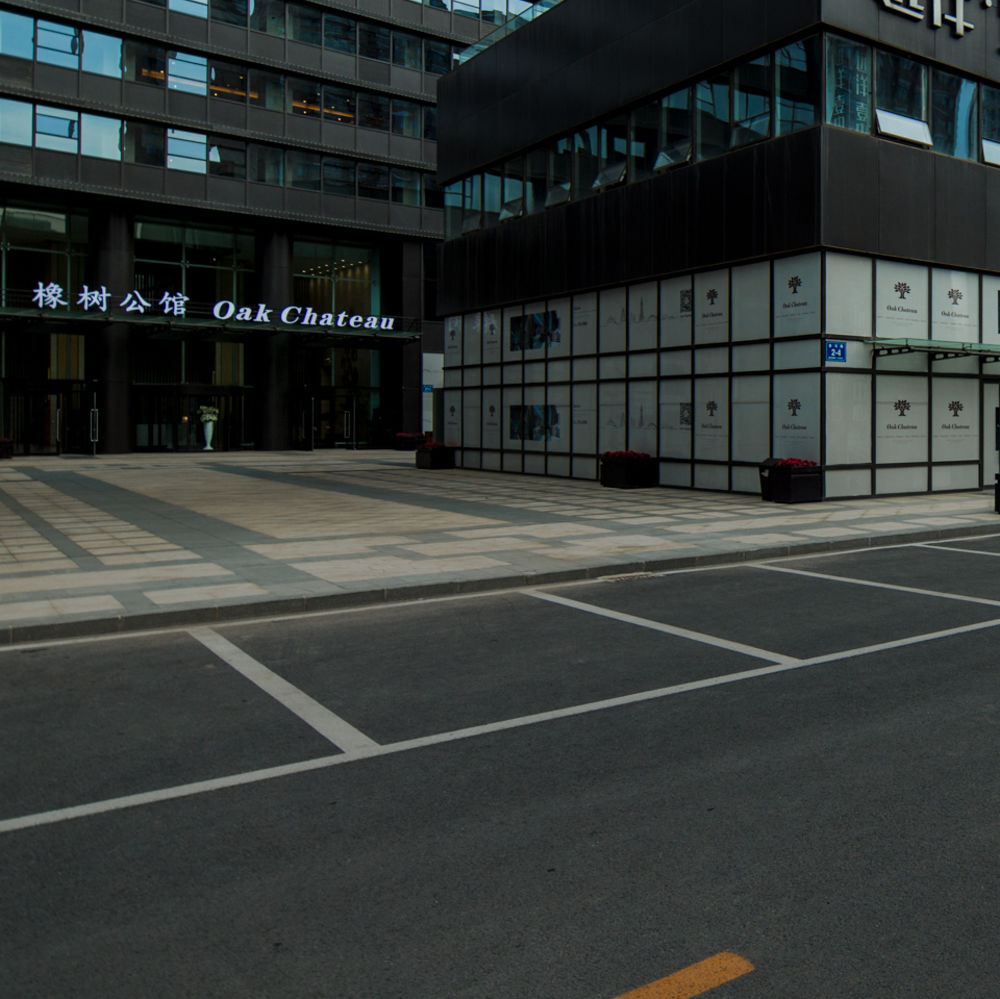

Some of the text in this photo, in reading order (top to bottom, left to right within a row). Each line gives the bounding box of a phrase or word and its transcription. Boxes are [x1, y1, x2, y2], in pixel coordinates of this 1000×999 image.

[31, 280, 191, 317] 橡树公馆
[212, 299, 396, 331] Oak Chateau
